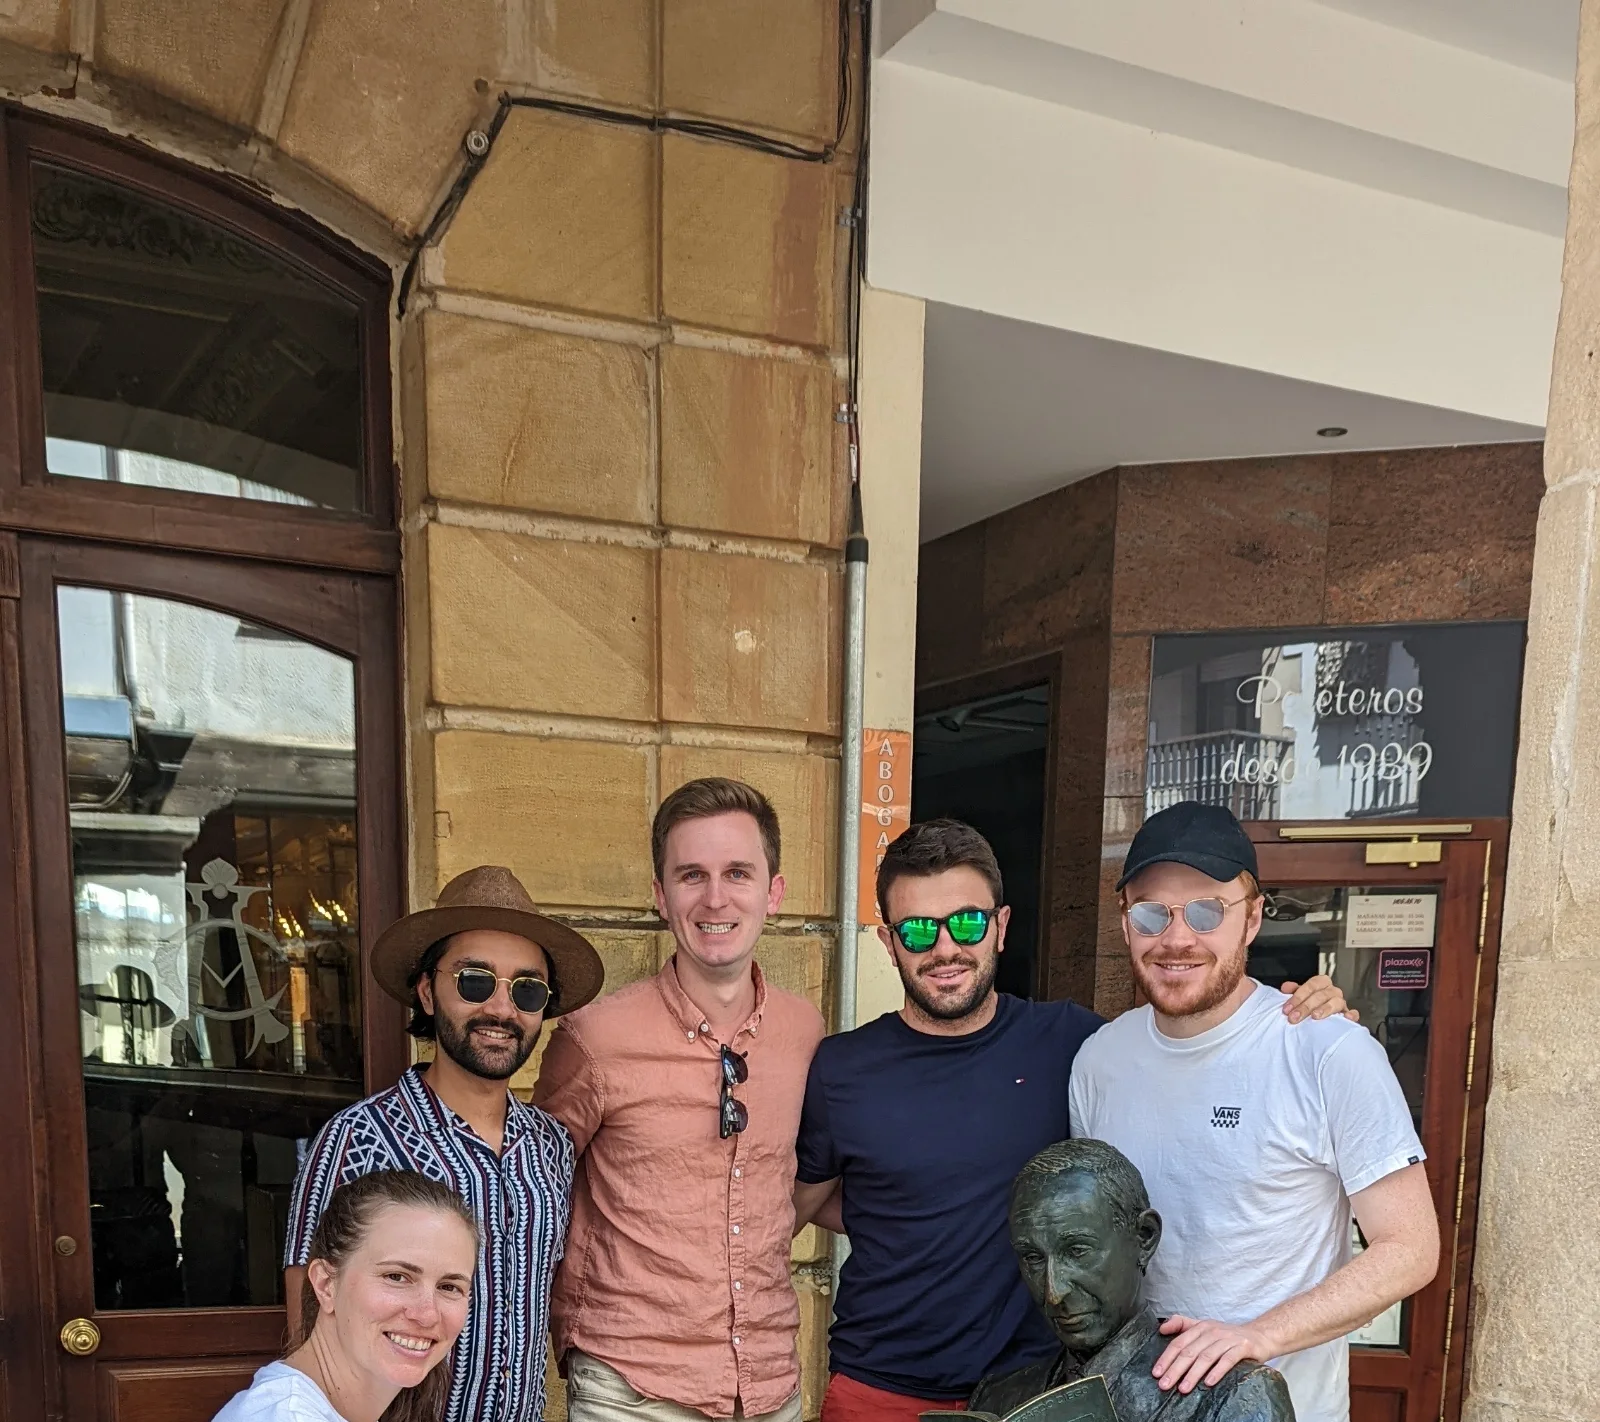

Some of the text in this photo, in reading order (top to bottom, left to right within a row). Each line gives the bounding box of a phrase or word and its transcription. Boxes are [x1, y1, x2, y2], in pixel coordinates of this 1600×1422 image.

[1236, 674, 1424, 718] Peeteros
[876, 738, 895, 919] ABOGA
[1213, 1106, 1242, 1119] VANS
[1056, 1386, 1089, 1404] DIEGO
